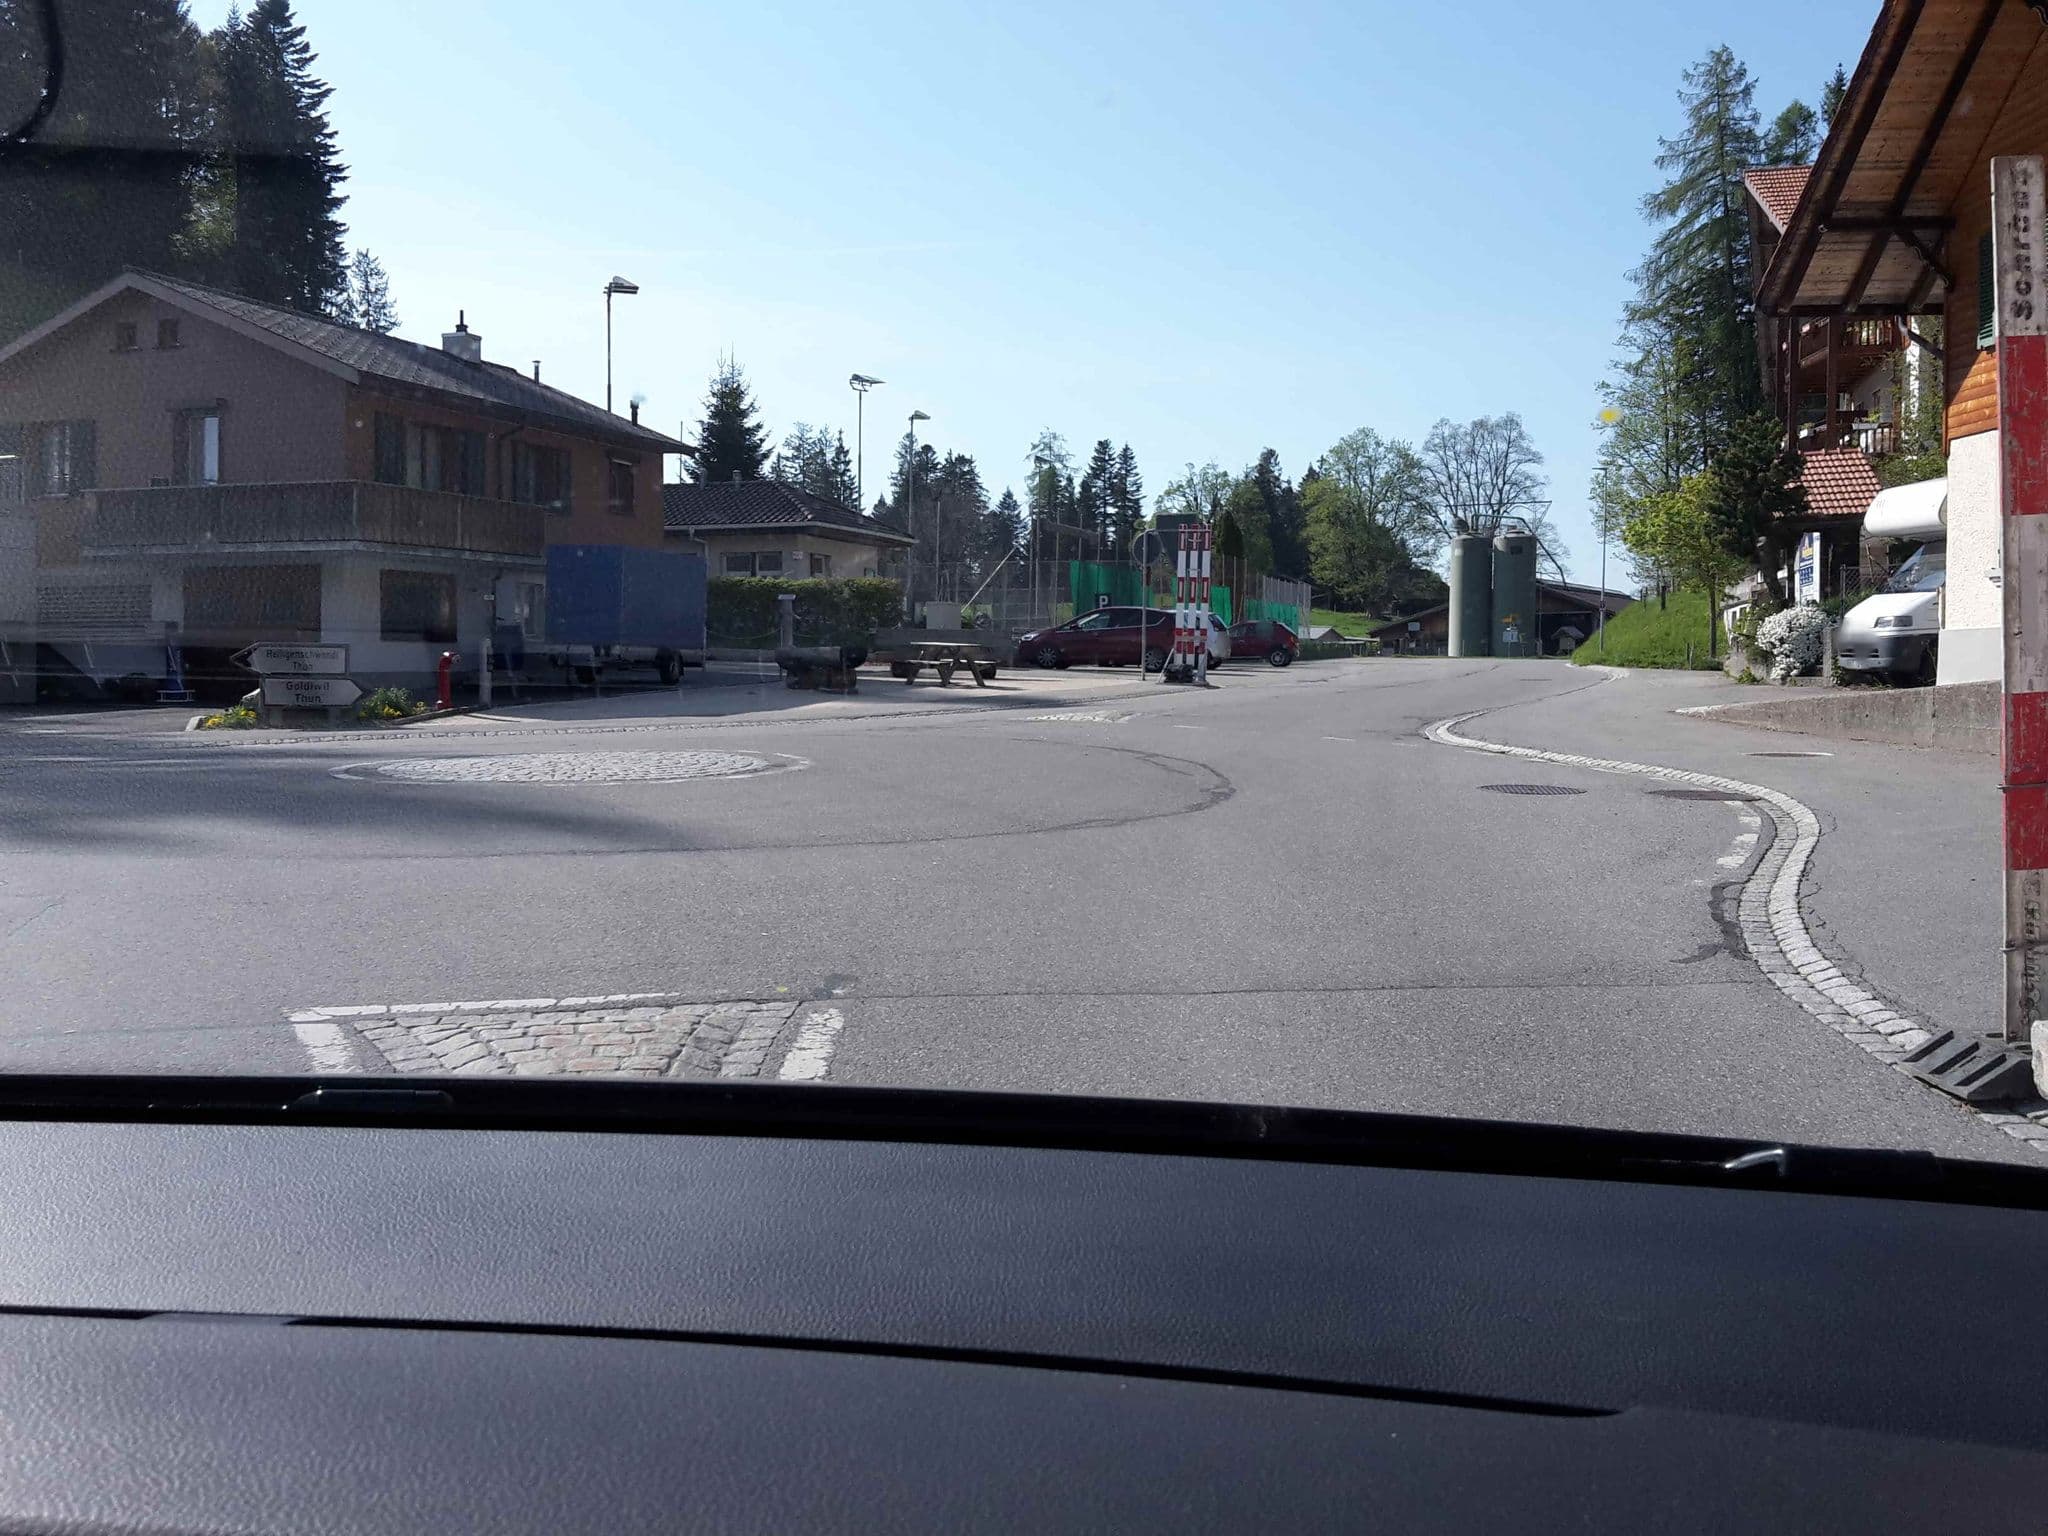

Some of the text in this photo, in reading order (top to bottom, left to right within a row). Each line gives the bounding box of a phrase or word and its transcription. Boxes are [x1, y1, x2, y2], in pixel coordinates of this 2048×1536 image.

[1099, 595, 1108, 608] P
[286, 681, 330, 691] Goldiwil
[295, 693, 322, 703] Thun
